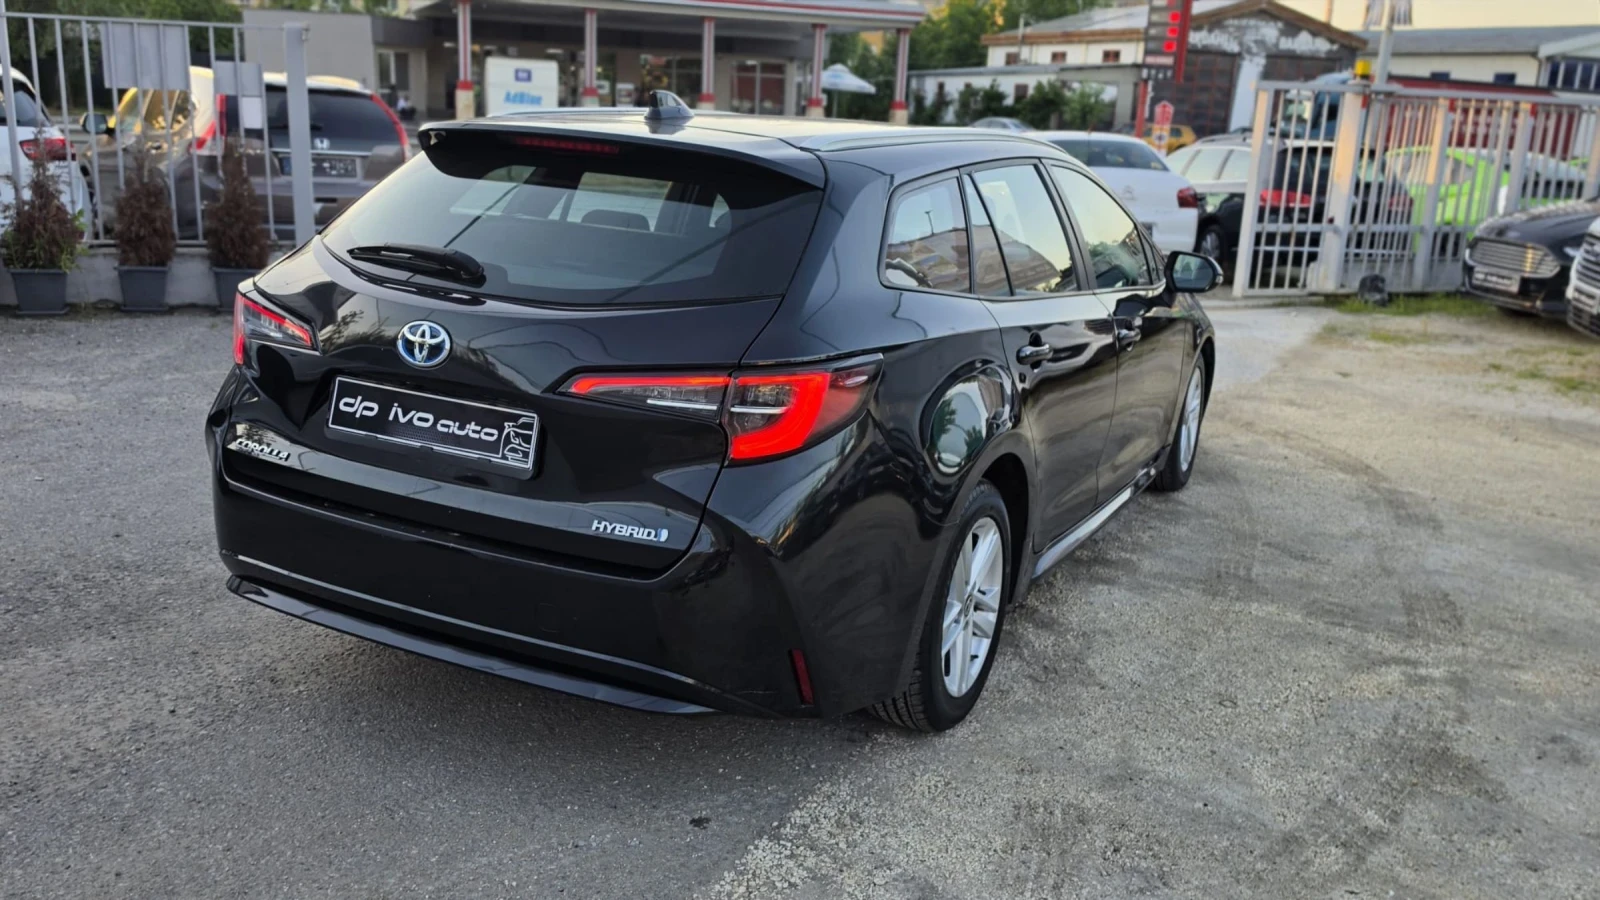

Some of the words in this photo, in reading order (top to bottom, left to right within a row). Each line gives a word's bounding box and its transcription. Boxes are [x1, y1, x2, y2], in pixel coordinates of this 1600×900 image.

[504, 90, 542, 105] AdBlue
[338, 395, 379, 419] dp
[388, 402, 434, 428] ivo
[436, 418, 499, 442] auto
[236, 438, 290, 461] COROLLA
[591, 519, 656, 541] HYBRID
